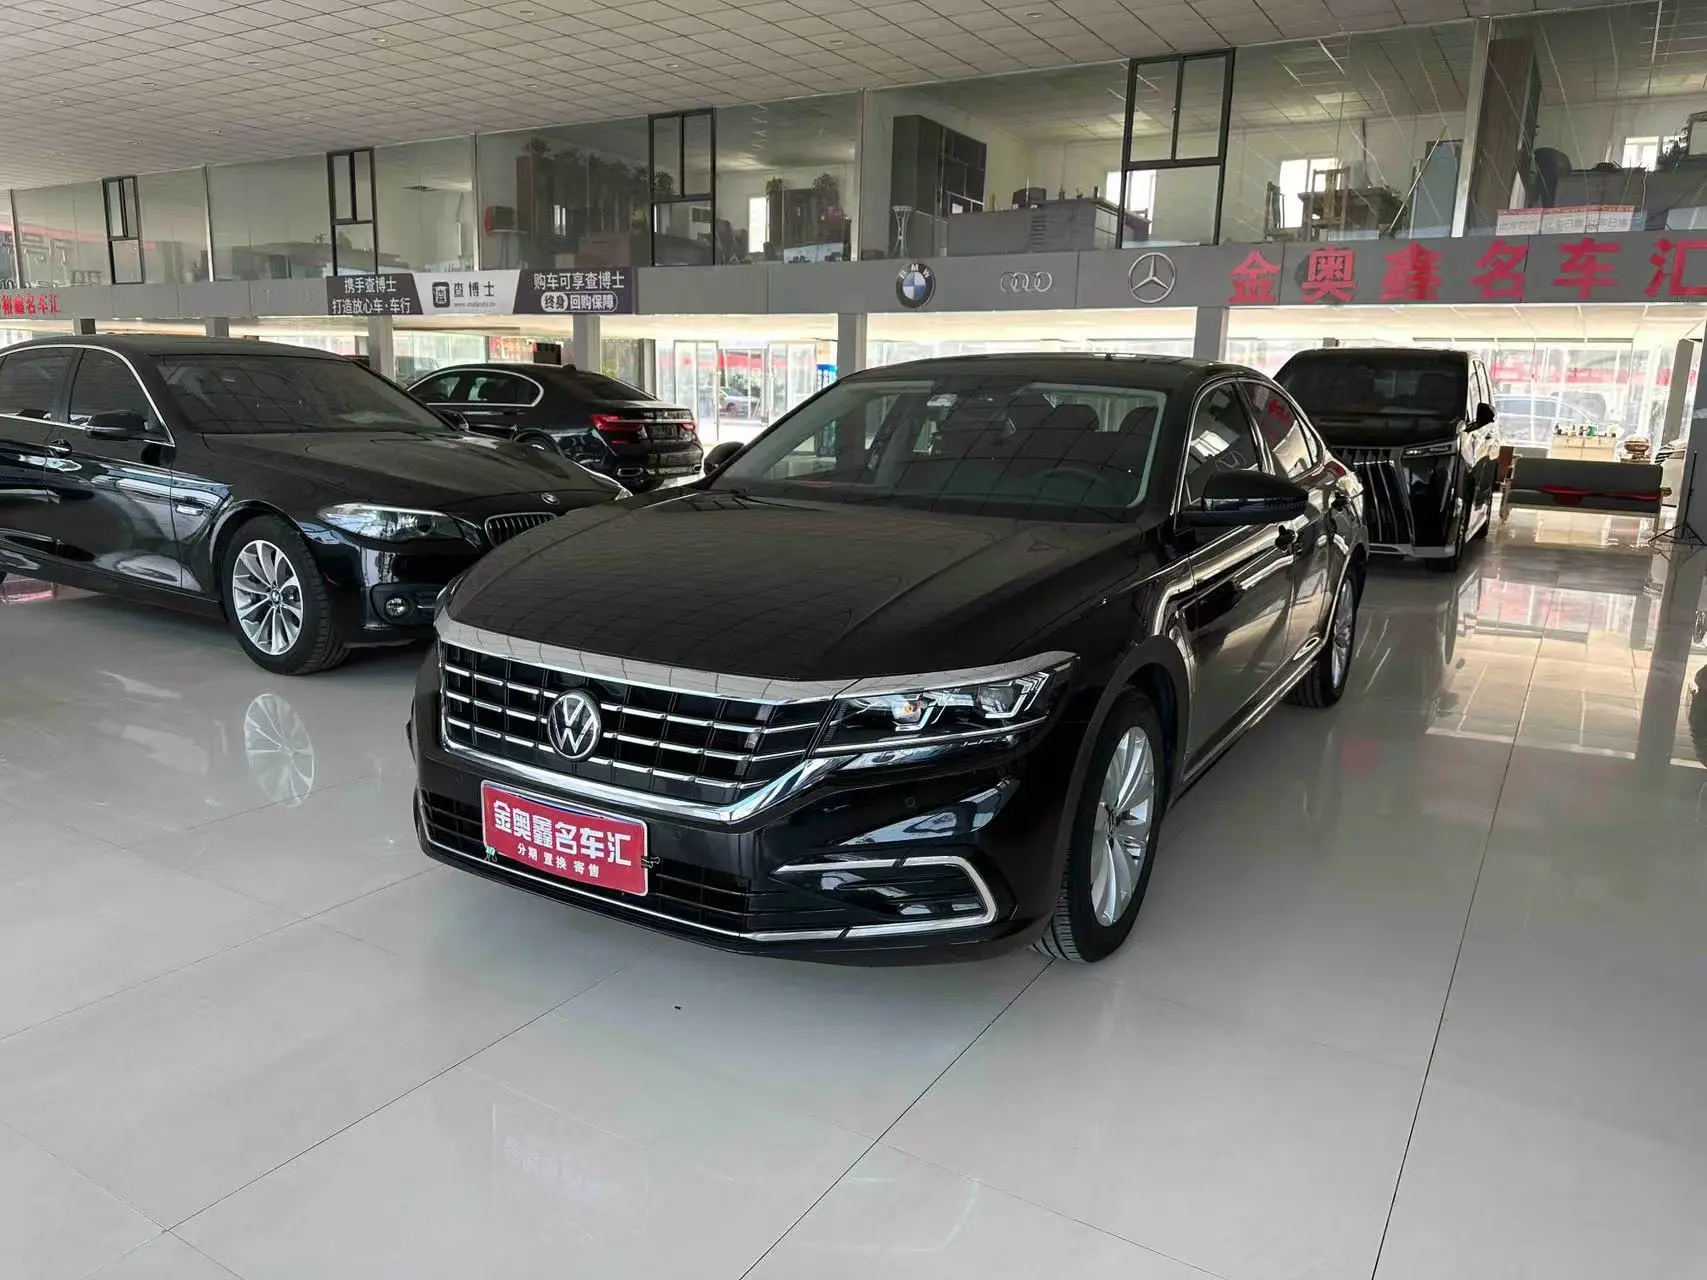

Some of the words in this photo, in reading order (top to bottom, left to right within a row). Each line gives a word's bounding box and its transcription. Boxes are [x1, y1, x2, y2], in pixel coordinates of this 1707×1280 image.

[533, 270, 625, 290] 购车可享查博士
[1229, 237, 1707, 304] 金奥鑫名车汇
[344, 276, 397, 294] 携手查博士
[453, 281, 495, 298] 查博士
[544, 294, 565, 310] 终身
[570, 294, 614, 310] 回购保障
[493, 800, 632, 867] 金奥鑫名车汇
[517, 842, 538, 861] 分期
[543, 852, 568, 870] 置换
[573, 860, 600, 878] 寄售
